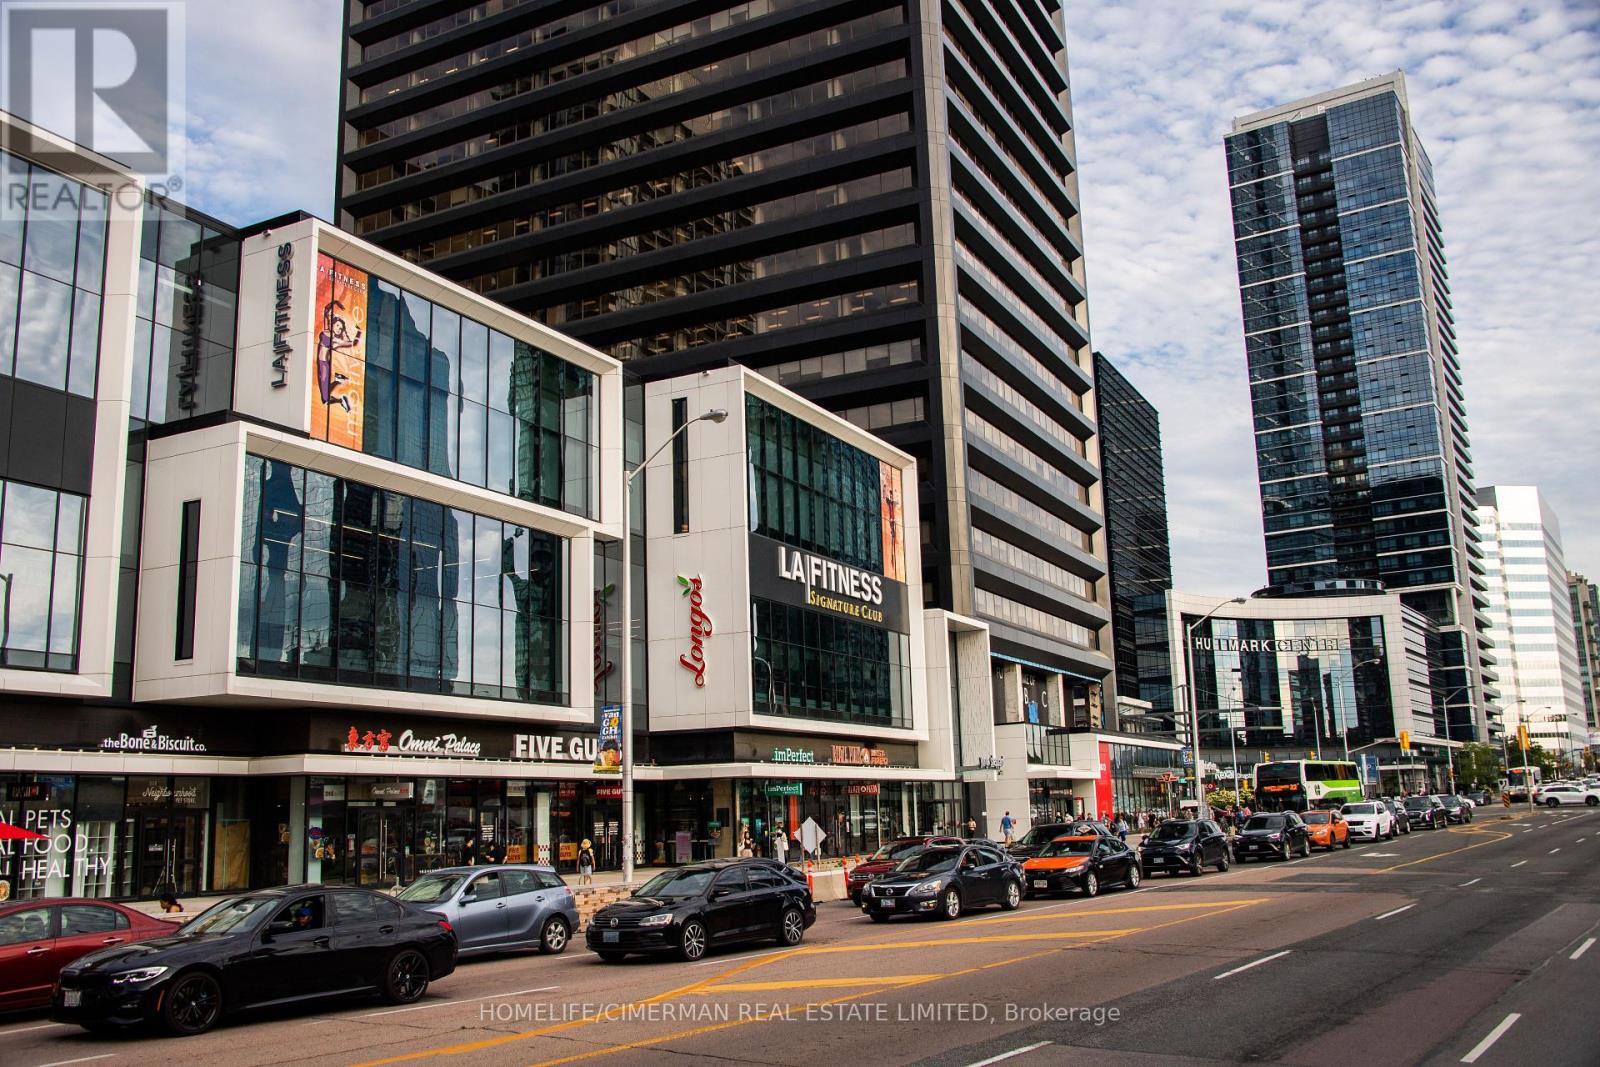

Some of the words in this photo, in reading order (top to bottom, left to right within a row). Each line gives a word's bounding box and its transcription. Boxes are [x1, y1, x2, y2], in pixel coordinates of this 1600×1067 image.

[810, 555, 883, 605] FITNESS
[1195, 637, 1271, 652] HULLMARK
[158, 735, 195, 751] Biscuit
[399, 729, 441, 752] Omni
[443, 733, 481, 755] Palace
[514, 734, 564, 759] FIVE
[596, 788, 611, 796] FIVE
